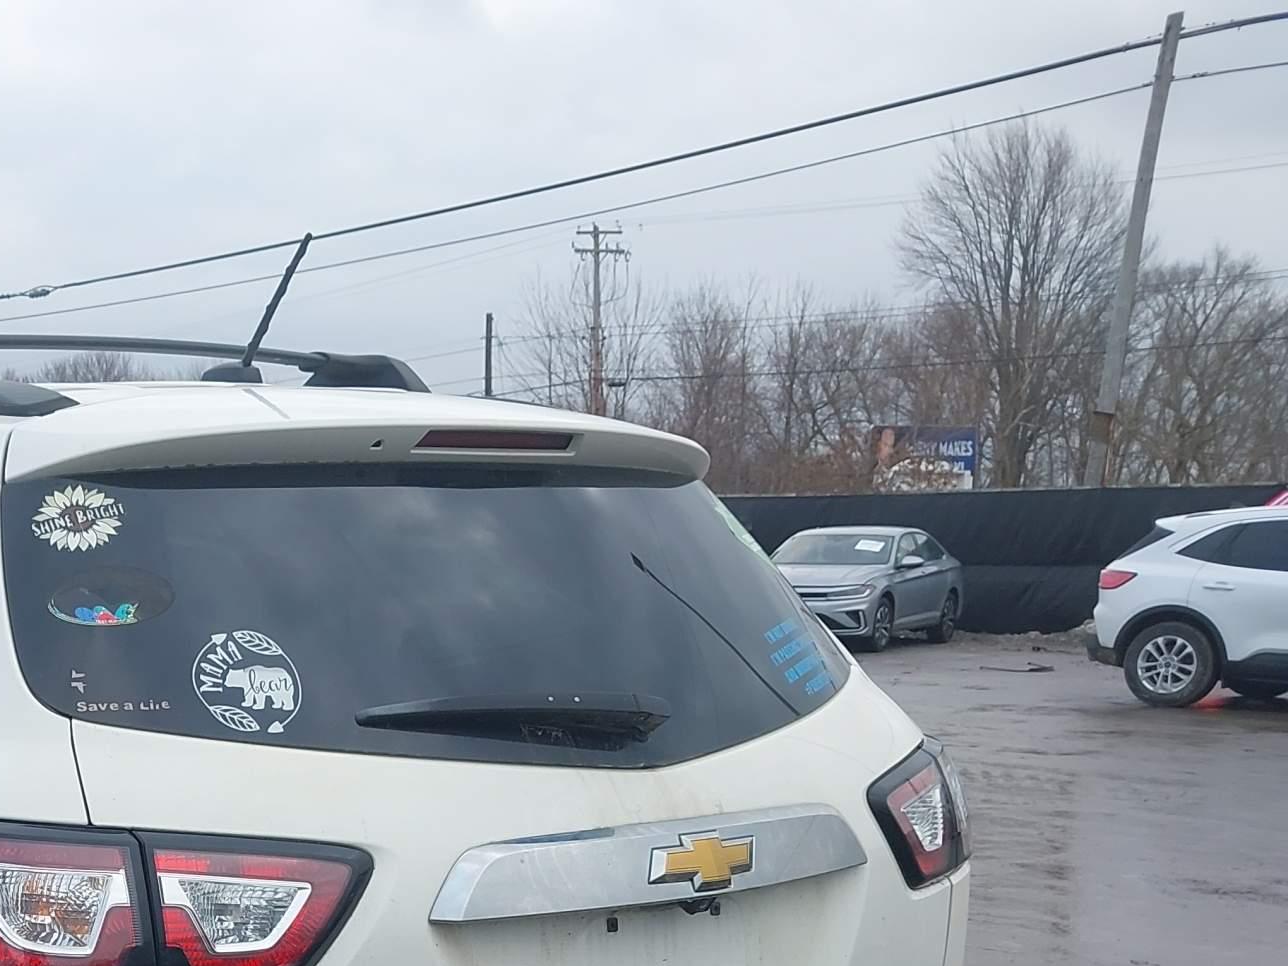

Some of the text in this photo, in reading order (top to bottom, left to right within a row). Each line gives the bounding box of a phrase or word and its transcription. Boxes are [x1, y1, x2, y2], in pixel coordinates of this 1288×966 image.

[939, 440, 974, 457] MAKES
[31, 503, 125, 537] SHINE BRIGHT
[199, 640, 243, 693] MAMA
[245, 669, 293, 696] bear
[76, 701, 119, 712] Save
[123, 702, 134, 711] a
